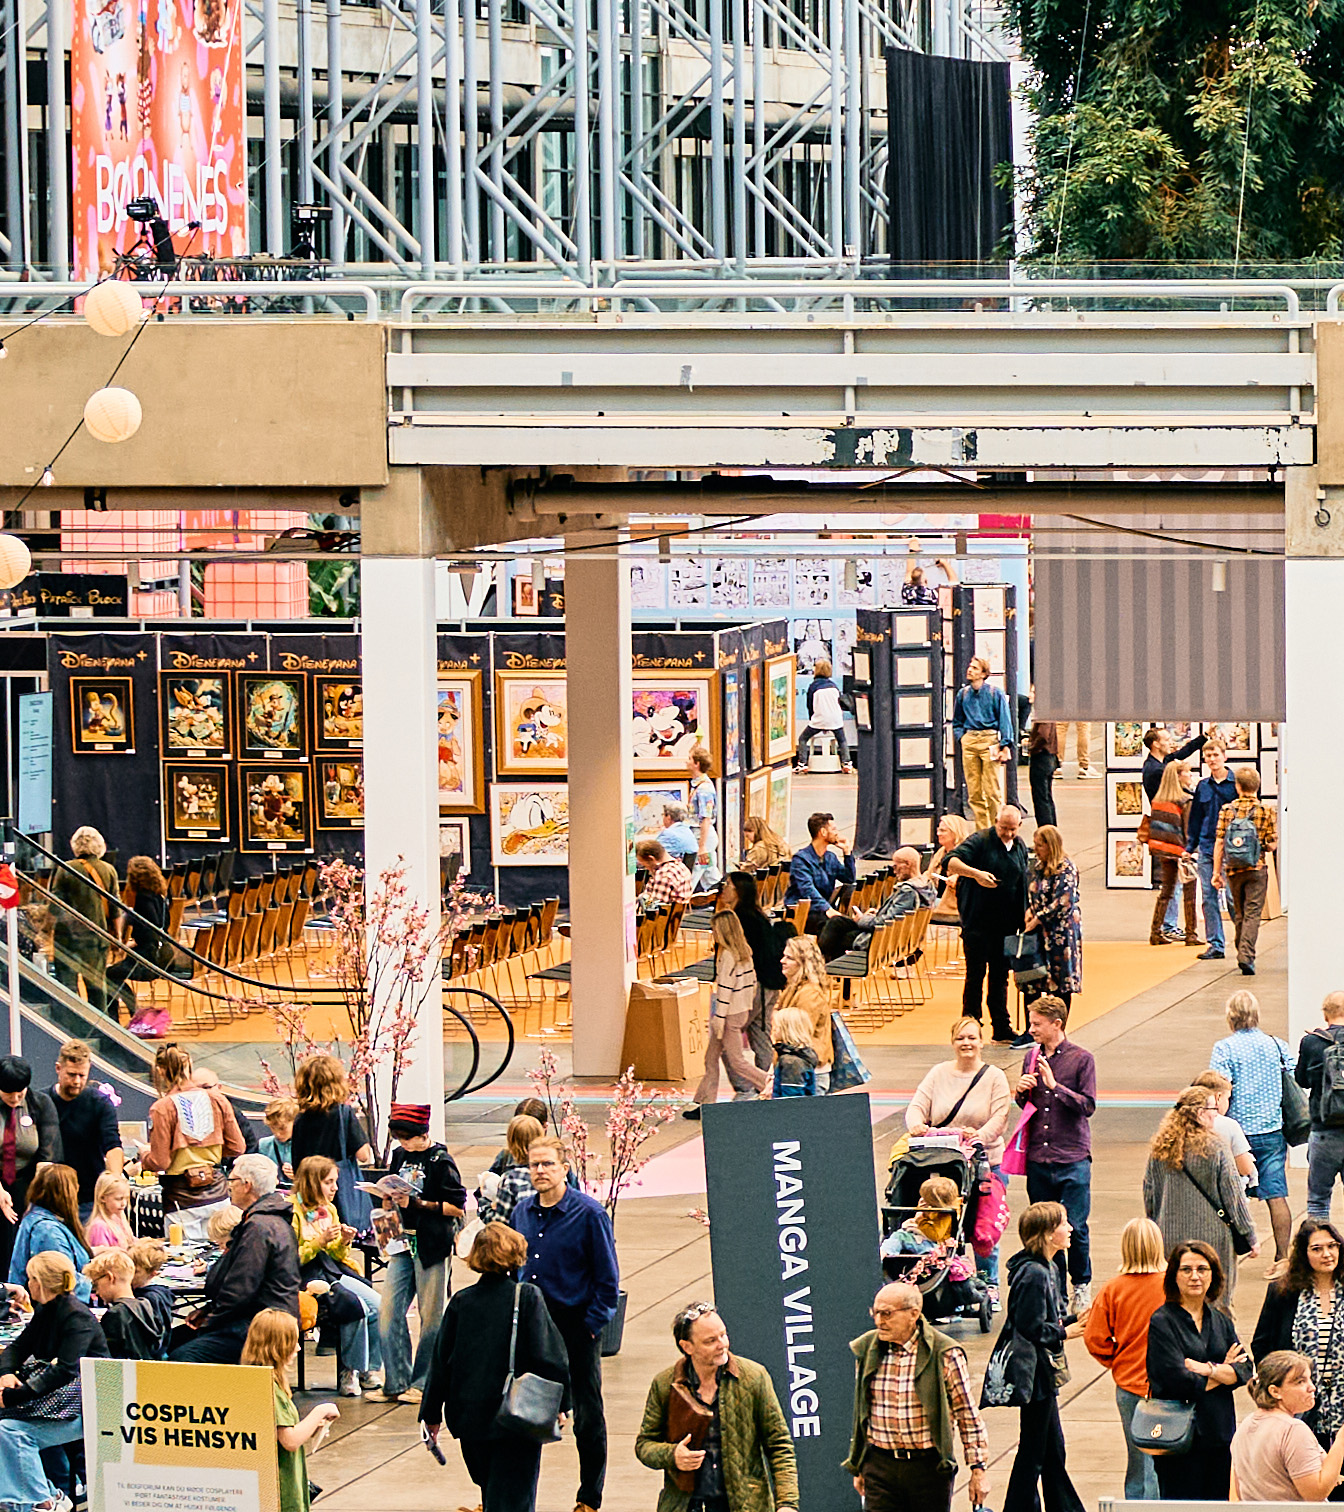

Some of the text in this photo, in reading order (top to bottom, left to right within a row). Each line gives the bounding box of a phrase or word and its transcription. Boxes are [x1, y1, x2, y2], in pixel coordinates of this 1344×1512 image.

[772, 1140, 821, 1438] MANGA VILLAGE
[126, 1403, 230, 1425] COSPLAY
[120, 1425, 157, 1445] VIS
[164, 1428, 258, 1450] HENSYN
